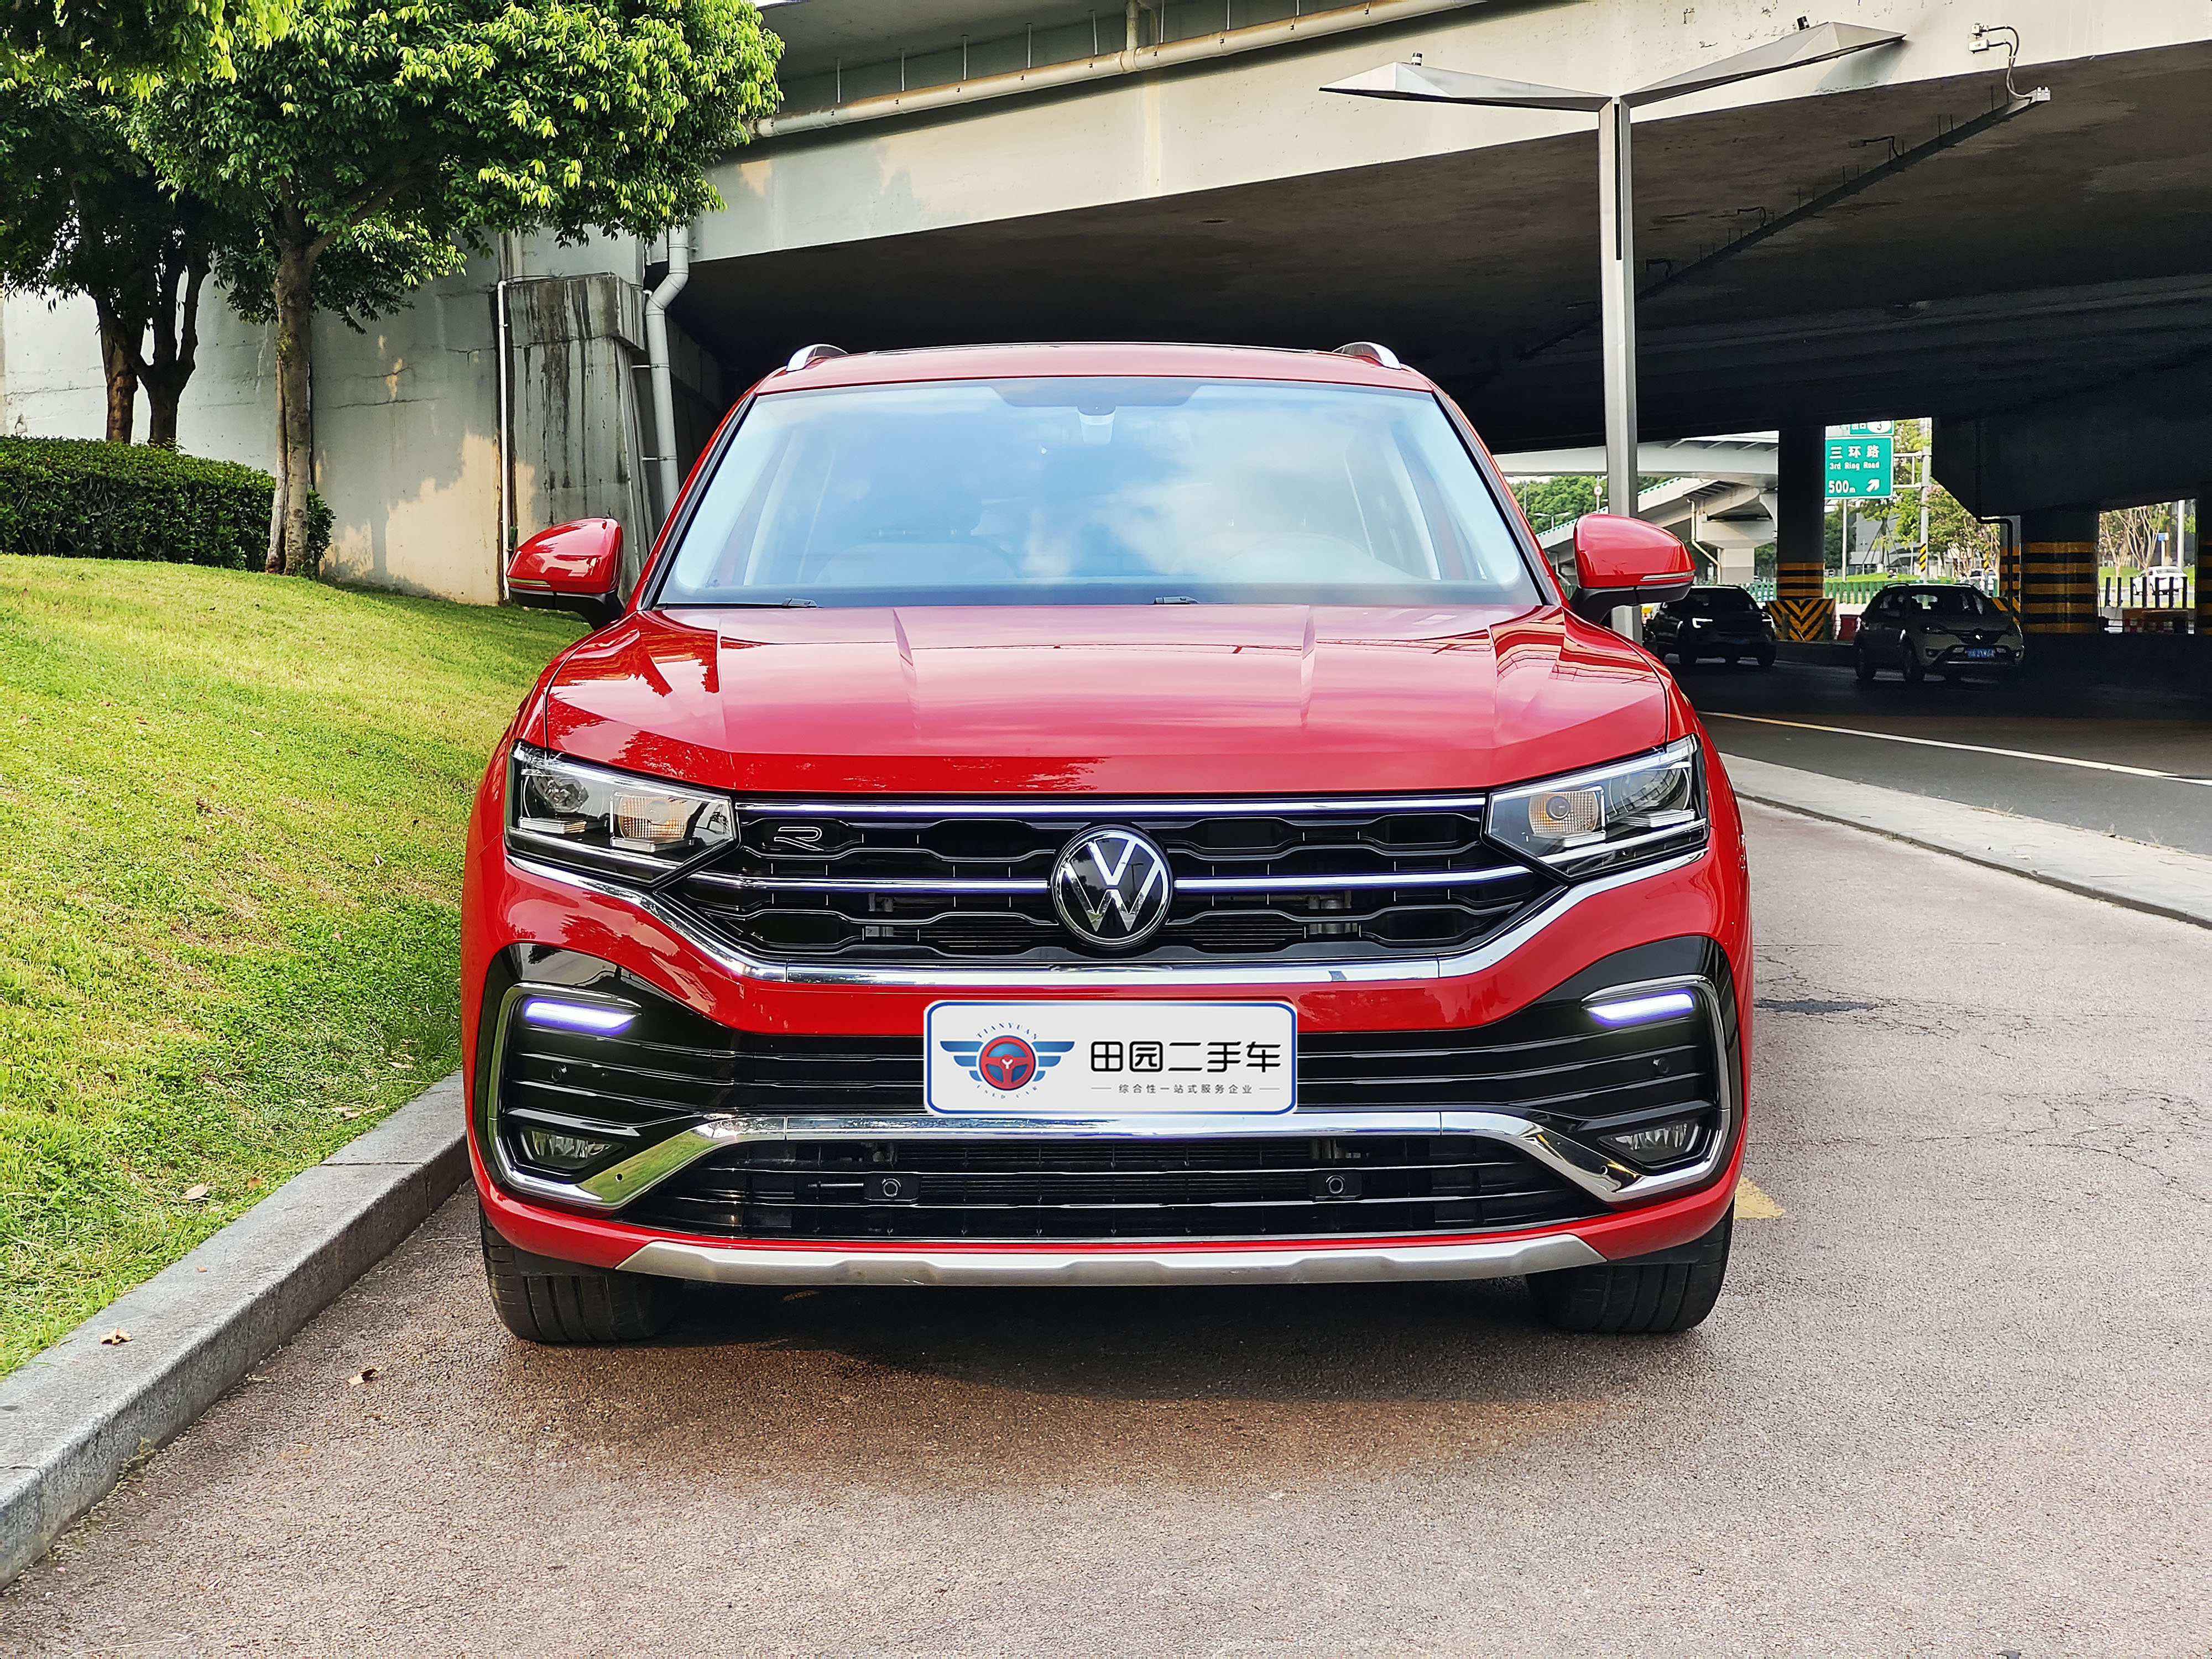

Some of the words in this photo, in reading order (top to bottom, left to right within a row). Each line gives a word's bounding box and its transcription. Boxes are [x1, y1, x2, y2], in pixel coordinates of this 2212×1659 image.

[1829, 445, 1880, 459] 三环路
[1844, 462, 1860, 471] Ring
[1828, 480, 1856, 493] 500m
